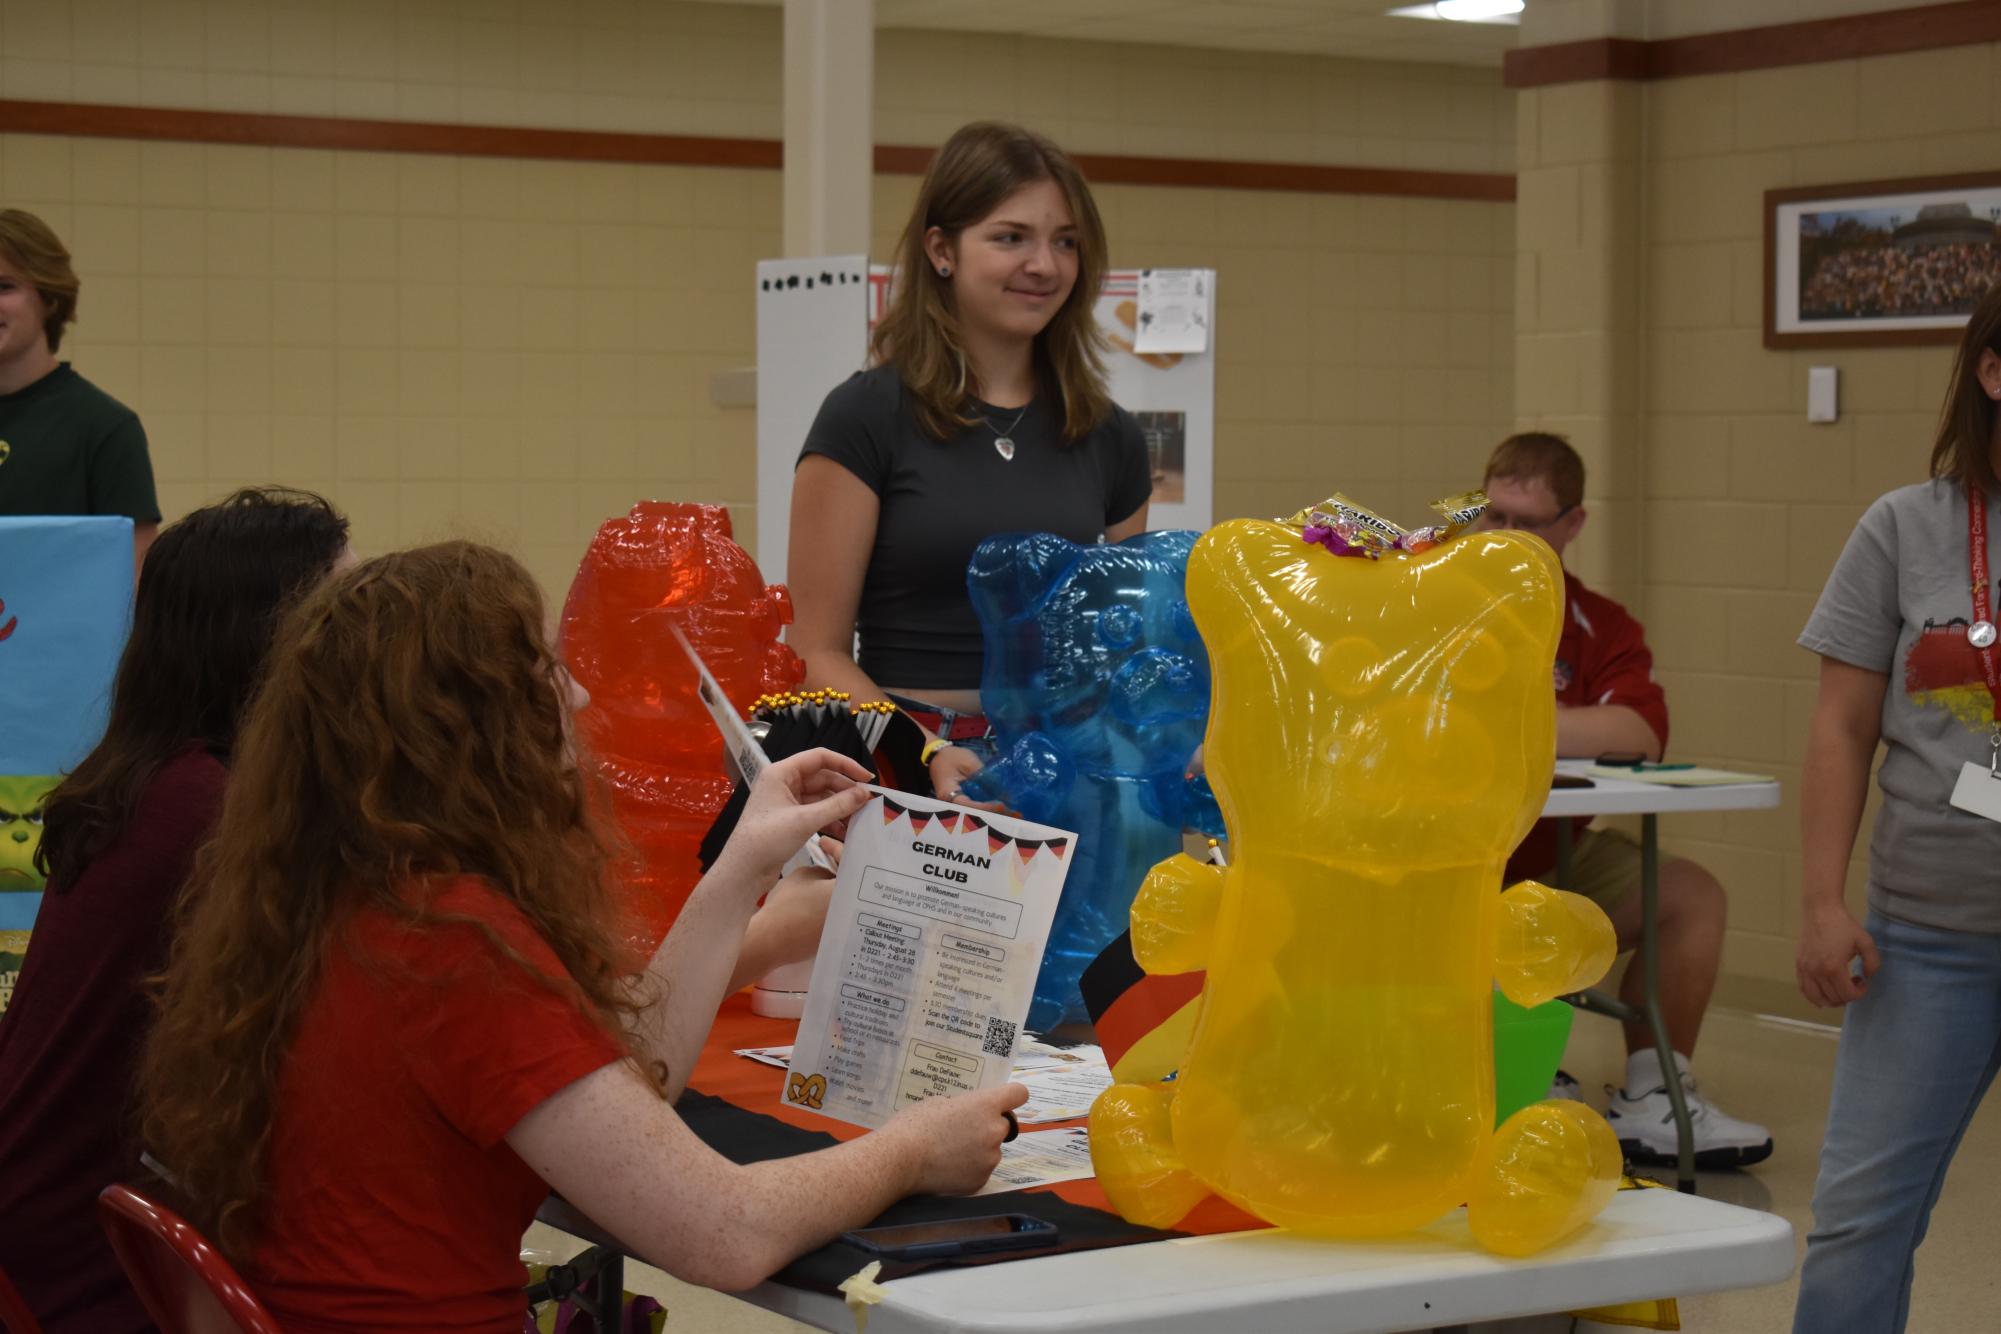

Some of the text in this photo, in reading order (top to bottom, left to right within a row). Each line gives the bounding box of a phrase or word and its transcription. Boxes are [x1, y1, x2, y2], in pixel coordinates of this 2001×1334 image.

[912, 841, 991, 870] GERMAN
[923, 863, 969, 884] CLUB
[926, 885, 960, 900] Willkommen!
[874, 882, 884, 890] Our
[918, 894, 940, 905] promote
[986, 912, 1007, 921] cultures
[892, 895, 915, 907] language
[937, 907, 947, 915] and
[877, 920, 903, 933] Meetings
[866, 929, 883, 938] Callout
[867, 948, 881, 956] D221
[888, 944, 908, 955] August
[956, 941, 991, 956] Membership
[858, 963, 884, 976] Thursdays
[896, 965, 913, 973] month
[963, 969, 984, 978] cultures
[857, 992, 873, 1000] What
[959, 988, 983, 1000] meetings
[929, 1010, 941, 1018] Scan
[951, 1016, 960, 1024] QR
[961, 1019, 974, 1027] code
[936, 1052, 958, 1063] Contact
[927, 1064, 939, 1072] Frau
[924, 1089, 936, 1097] Frau
[934, 1084, 948, 1092] D221
